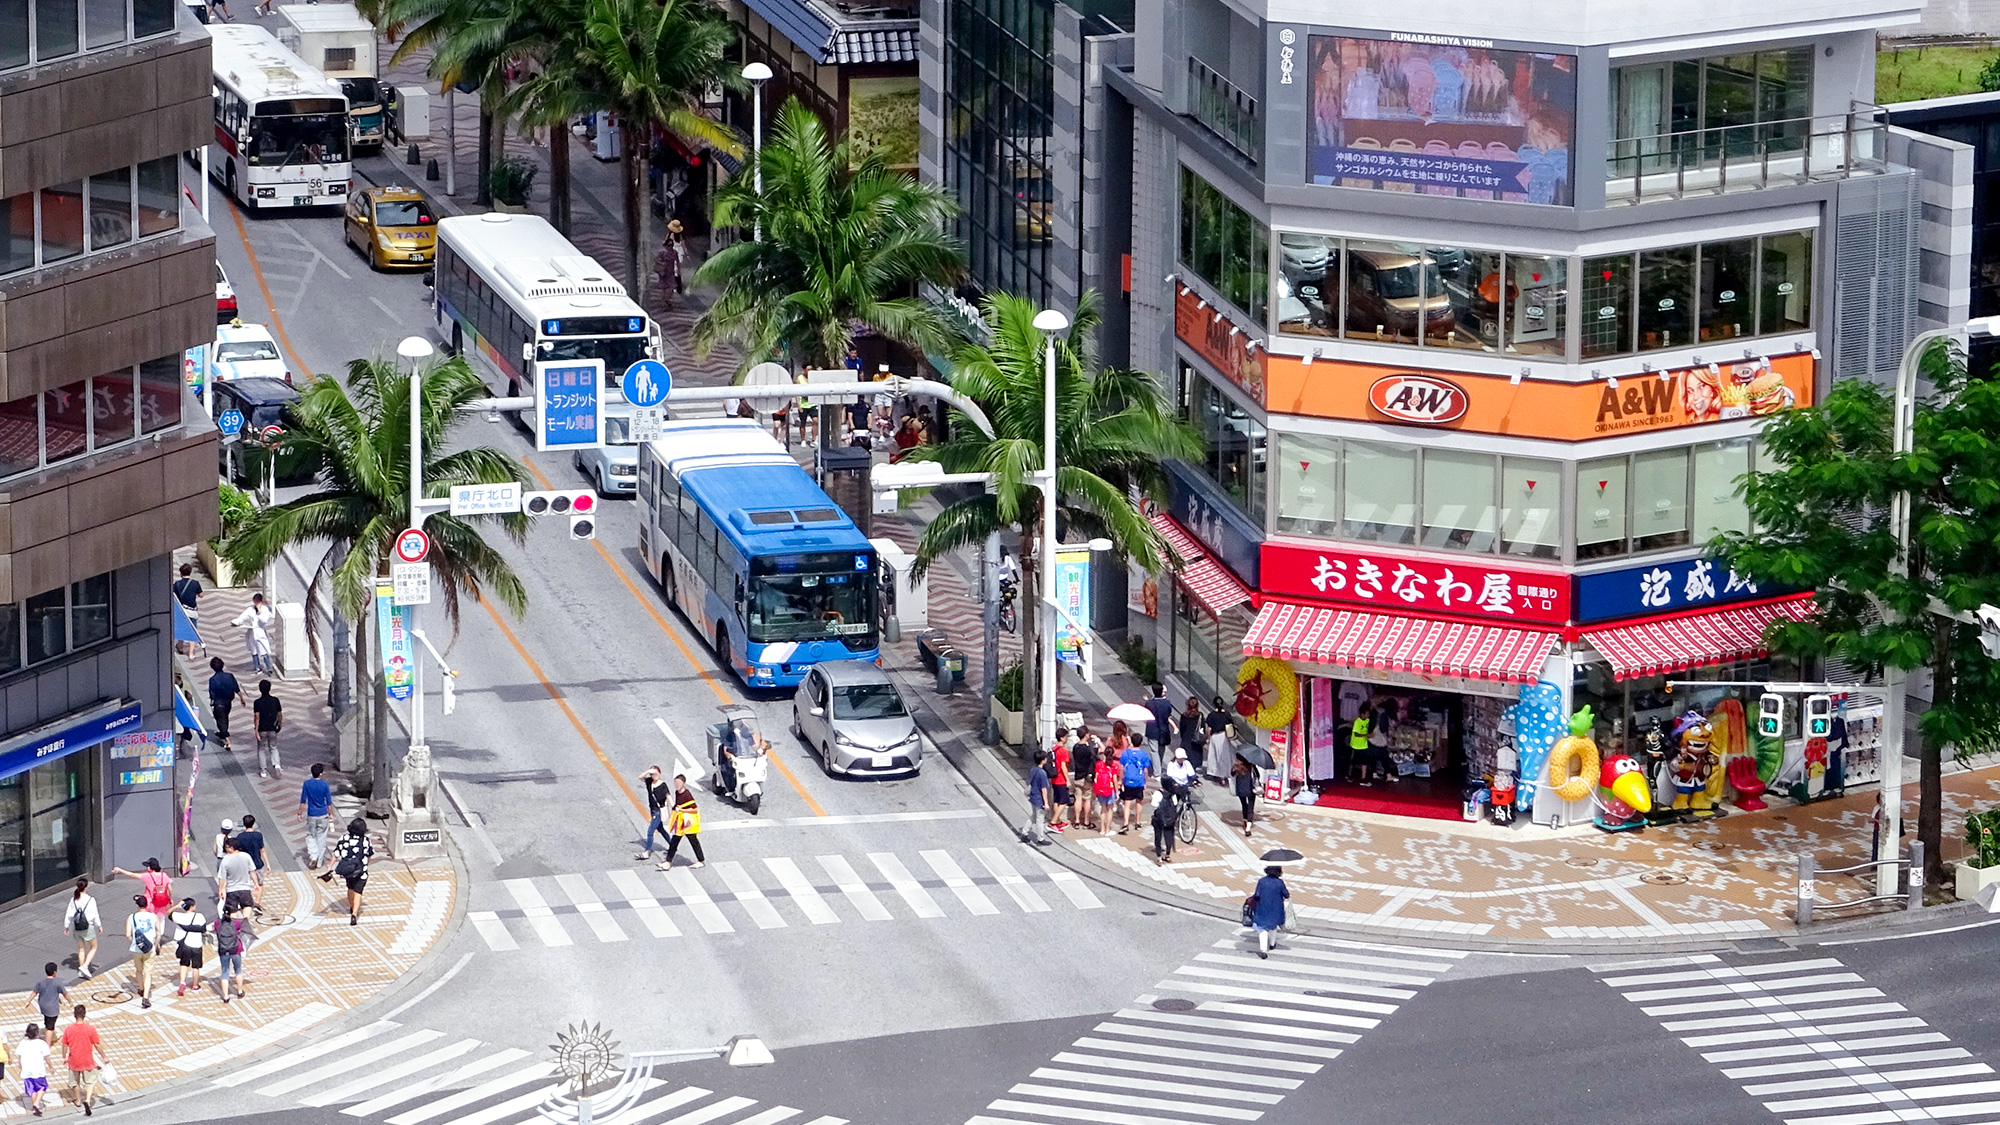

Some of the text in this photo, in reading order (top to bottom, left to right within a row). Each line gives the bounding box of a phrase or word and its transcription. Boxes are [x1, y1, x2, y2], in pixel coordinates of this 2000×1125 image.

[1390, 31, 1493, 48] FUNABASHIYA VISION
[310, 178, 322, 188] 56
[395, 231, 430, 239] TAXI
[548, 370, 592, 388] 日曜日
[545, 393, 596, 409] トランジット
[1386, 385, 1453, 415] A&W
[1596, 376, 1679, 423] A&W
[223, 415, 240, 427] 39
[547, 414, 595, 431] モール実施
[1594, 414, 1674, 433] OKINAWA SINCE 1963
[459, 488, 512, 502] 県庁北口
[1310, 555, 1514, 614] おきなわ屋
[1517, 584, 1558, 599] 国際通り
[1068, 572, 1080, 617] 観光月間
[1522, 598, 1552, 611] 入口
[391, 605, 403, 651] 観光月間
